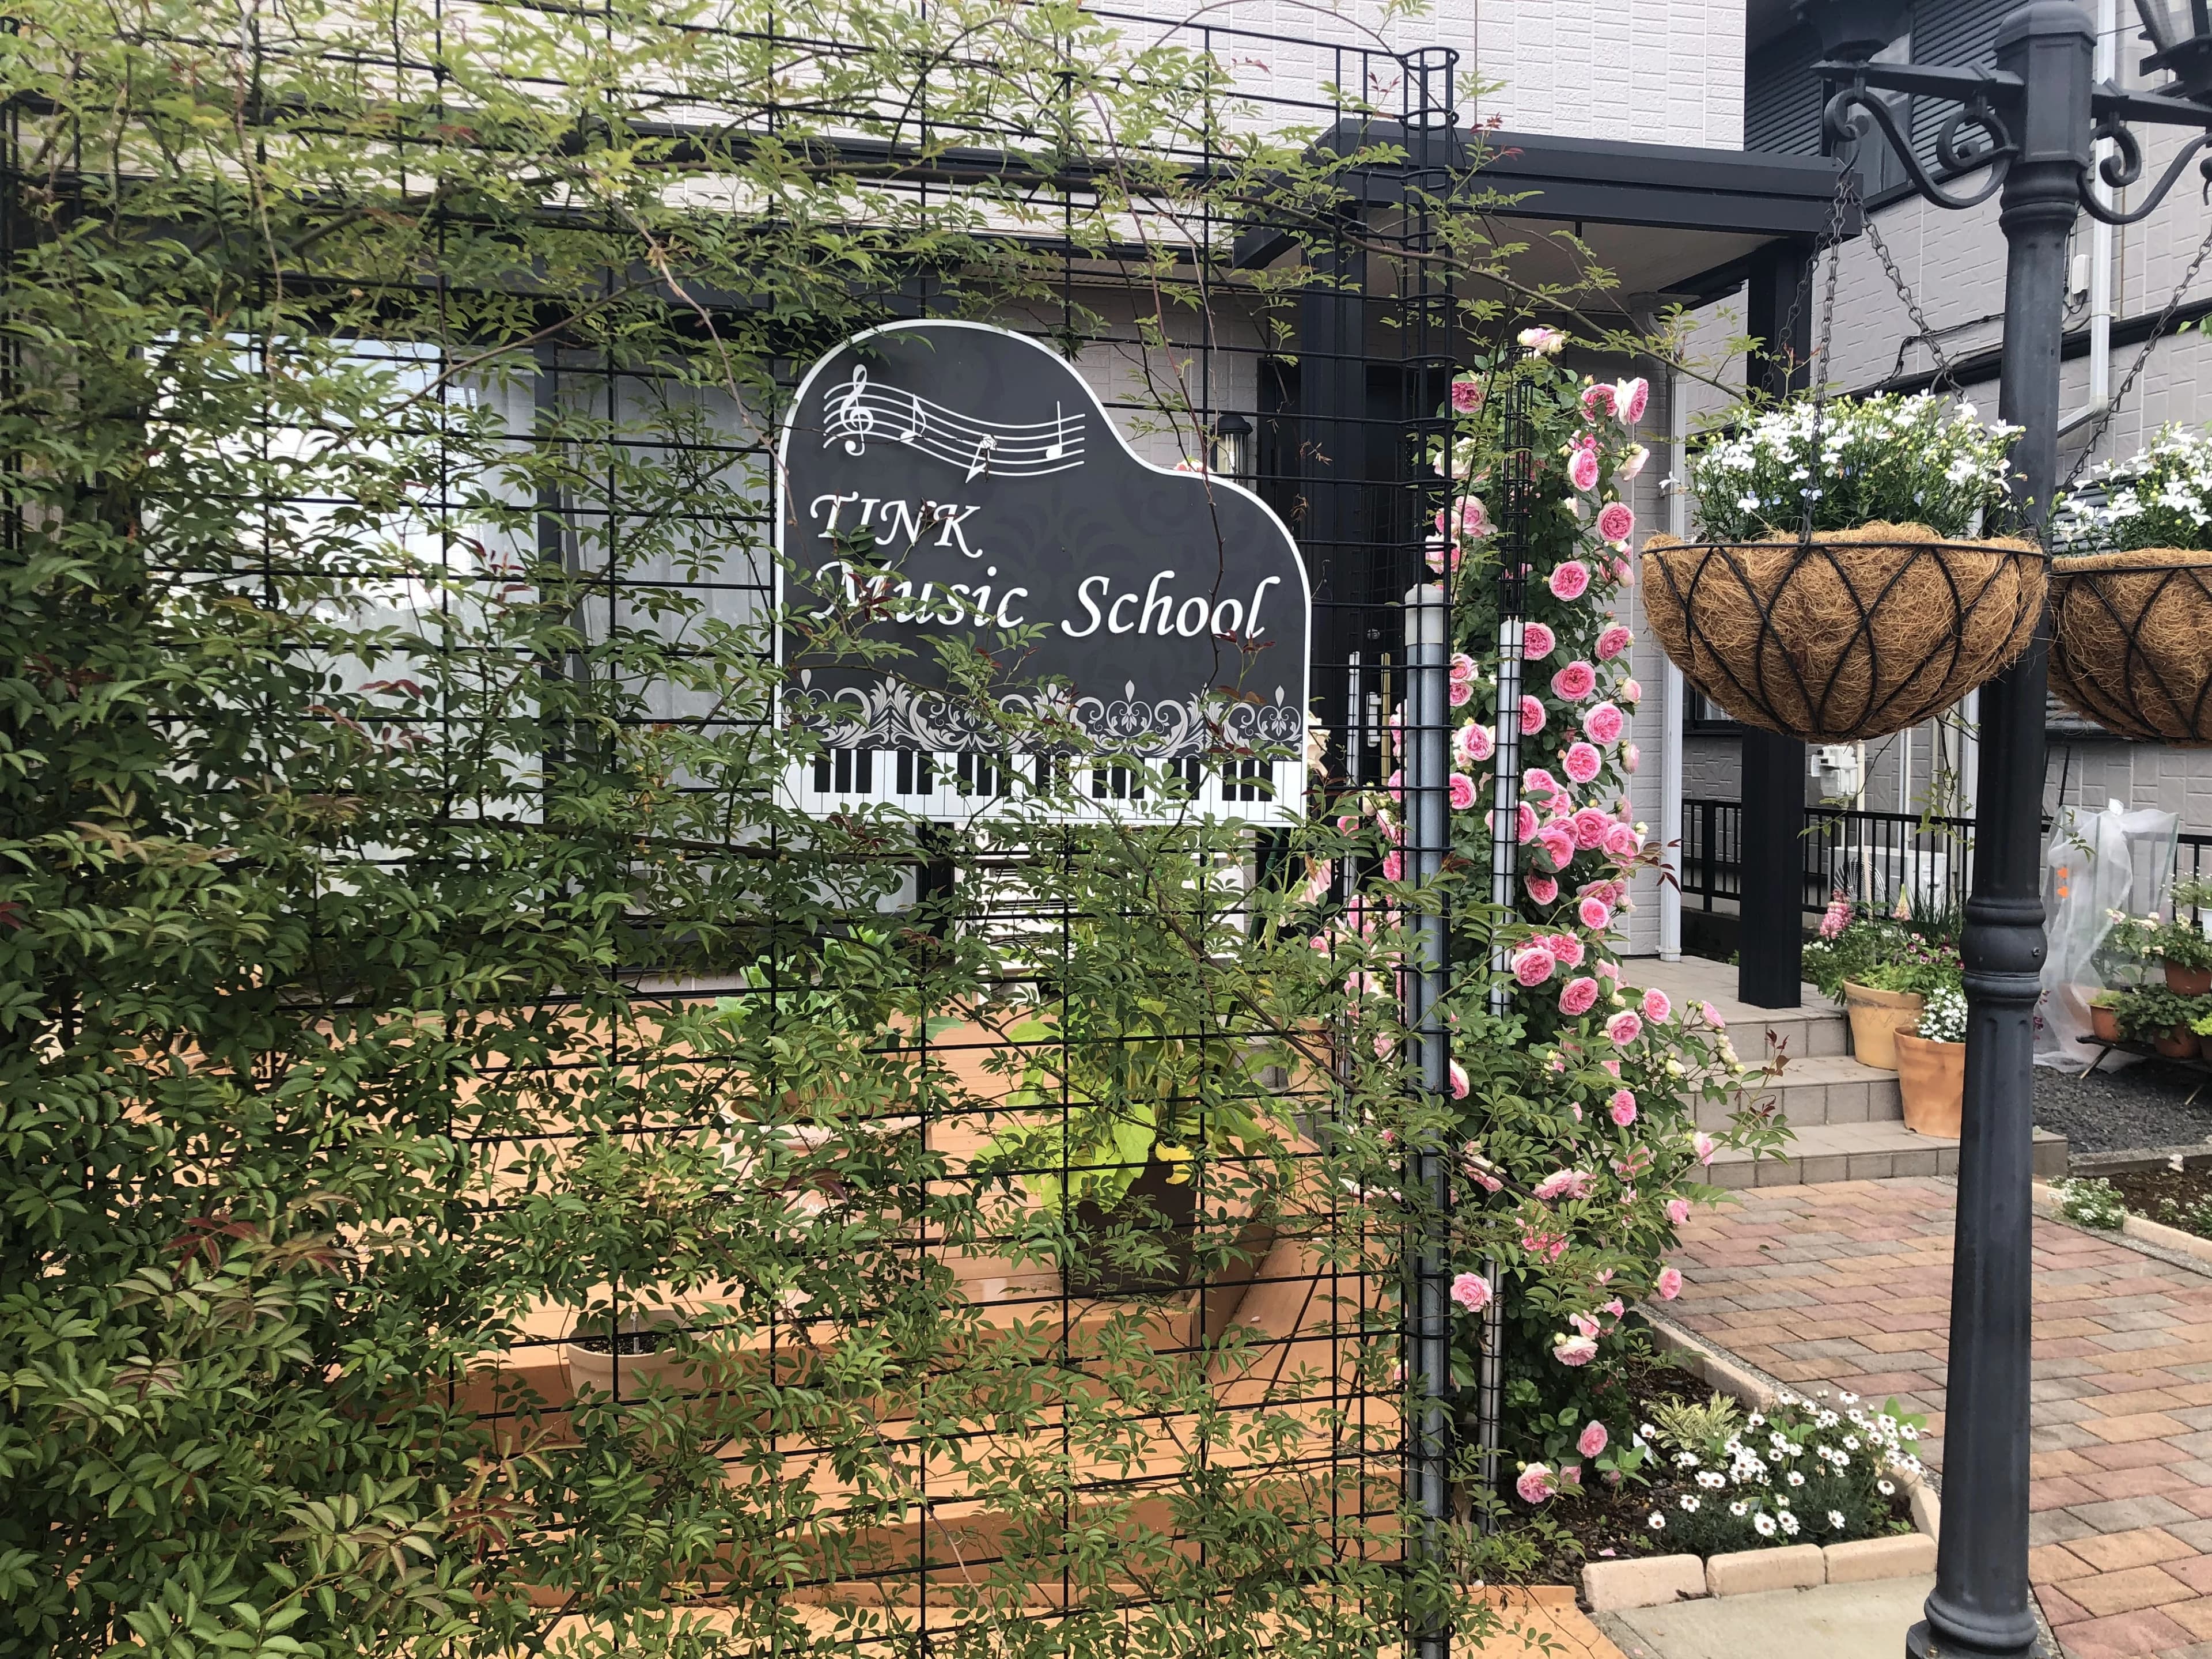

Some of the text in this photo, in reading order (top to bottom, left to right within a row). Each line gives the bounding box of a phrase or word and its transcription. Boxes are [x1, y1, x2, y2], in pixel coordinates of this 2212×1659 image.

[809, 491, 983, 558] TINK
[809, 560, 1281, 640] Music School
